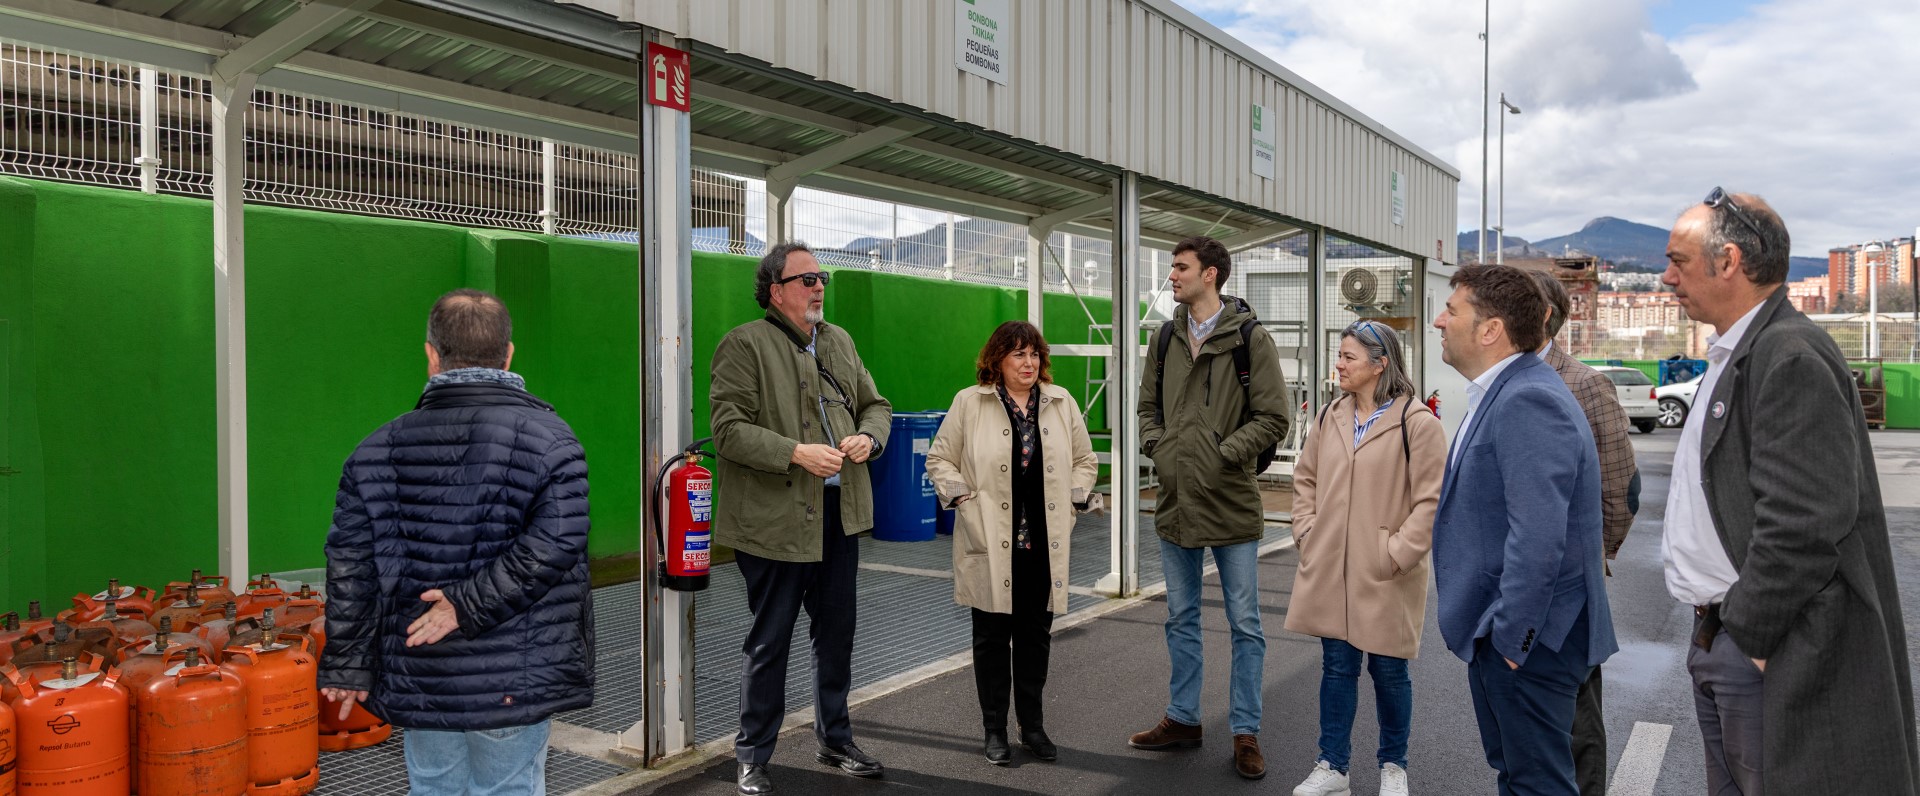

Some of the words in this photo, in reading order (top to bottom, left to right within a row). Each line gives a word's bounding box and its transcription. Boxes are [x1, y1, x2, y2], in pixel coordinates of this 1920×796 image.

[968, 10, 998, 31] BONBONA
[972, 25, 995, 43] TXIKIAK
[967, 39, 999, 60] PEQUEÑAS
[966, 52, 1000, 74] BOMBONAS
[39, 744, 62, 752] Repsol
[64, 740, 91, 749] Butano
